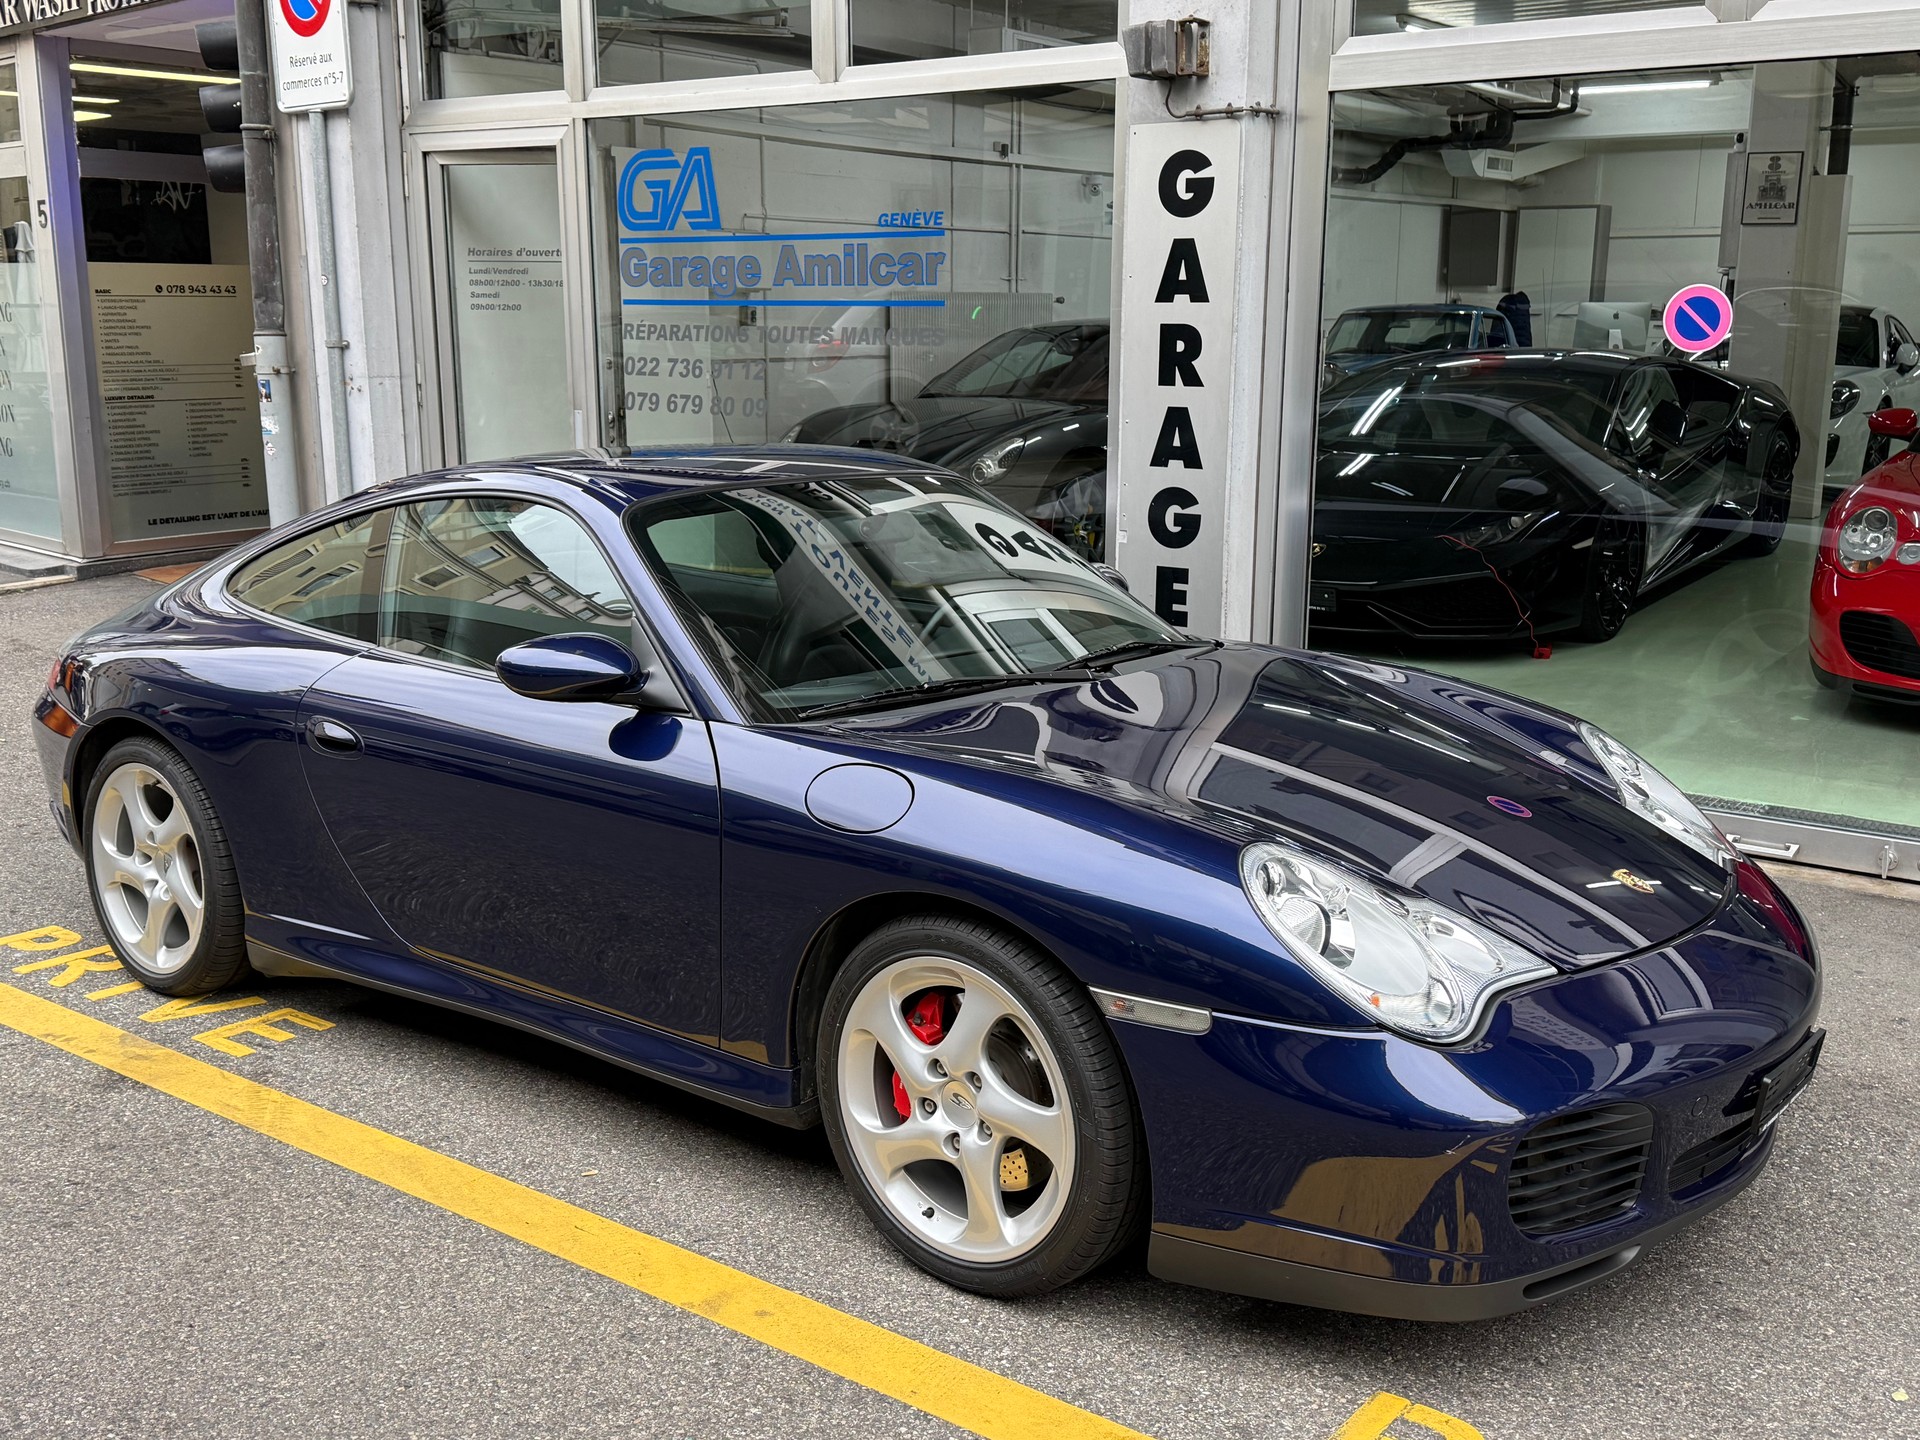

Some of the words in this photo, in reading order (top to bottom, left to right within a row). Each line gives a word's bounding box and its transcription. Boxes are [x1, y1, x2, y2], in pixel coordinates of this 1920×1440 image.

[289, 52, 317, 68] Réservé
[319, 53, 333, 64] aux
[282, 76, 322, 91] commerces
[323, 70, 344, 85] n°5-7
[617, 146, 722, 231] GA
[37, 199, 48, 229] 5
[1745, 202, 1796, 210] AMILCAR
[877, 207, 945, 228] GENÈVE
[467, 247, 513, 257] Horaires
[468, 267, 529, 275] Lundi/Vendredi
[620, 246, 762, 298] Garage
[772, 242, 947, 287] Amilcar
[166, 285, 186, 293] 078
[188, 285, 207, 294] 943
[209, 285, 222, 294] 43
[224, 285, 237, 294] 43
[469, 279, 520, 287] 08h00/12h00
[470, 291, 500, 299] Samedi
[470, 303, 522, 311] 09h00/12h00
[622, 319, 750, 344] RÉPARATIONS
[757, 325, 836, 345] TOUTES
[840, 326, 946, 347] MARQUES
[624, 355, 660, 377] 022
[667, 357, 704, 379] 736
[711, 359, 735, 380] 91
[741, 360, 766, 381] 12
[1147, 148, 1216, 628] GARAGE
[625, 390, 660, 412] 079
[666, 392, 704, 415] 679
[709, 395, 735, 417] 80
[742, 396, 769, 418] 09
[148, 518, 157, 526] LE
[159, 515, 201, 525] DETAILING
[202, 513, 215, 521] EST
[240, 510, 250, 518] DE
